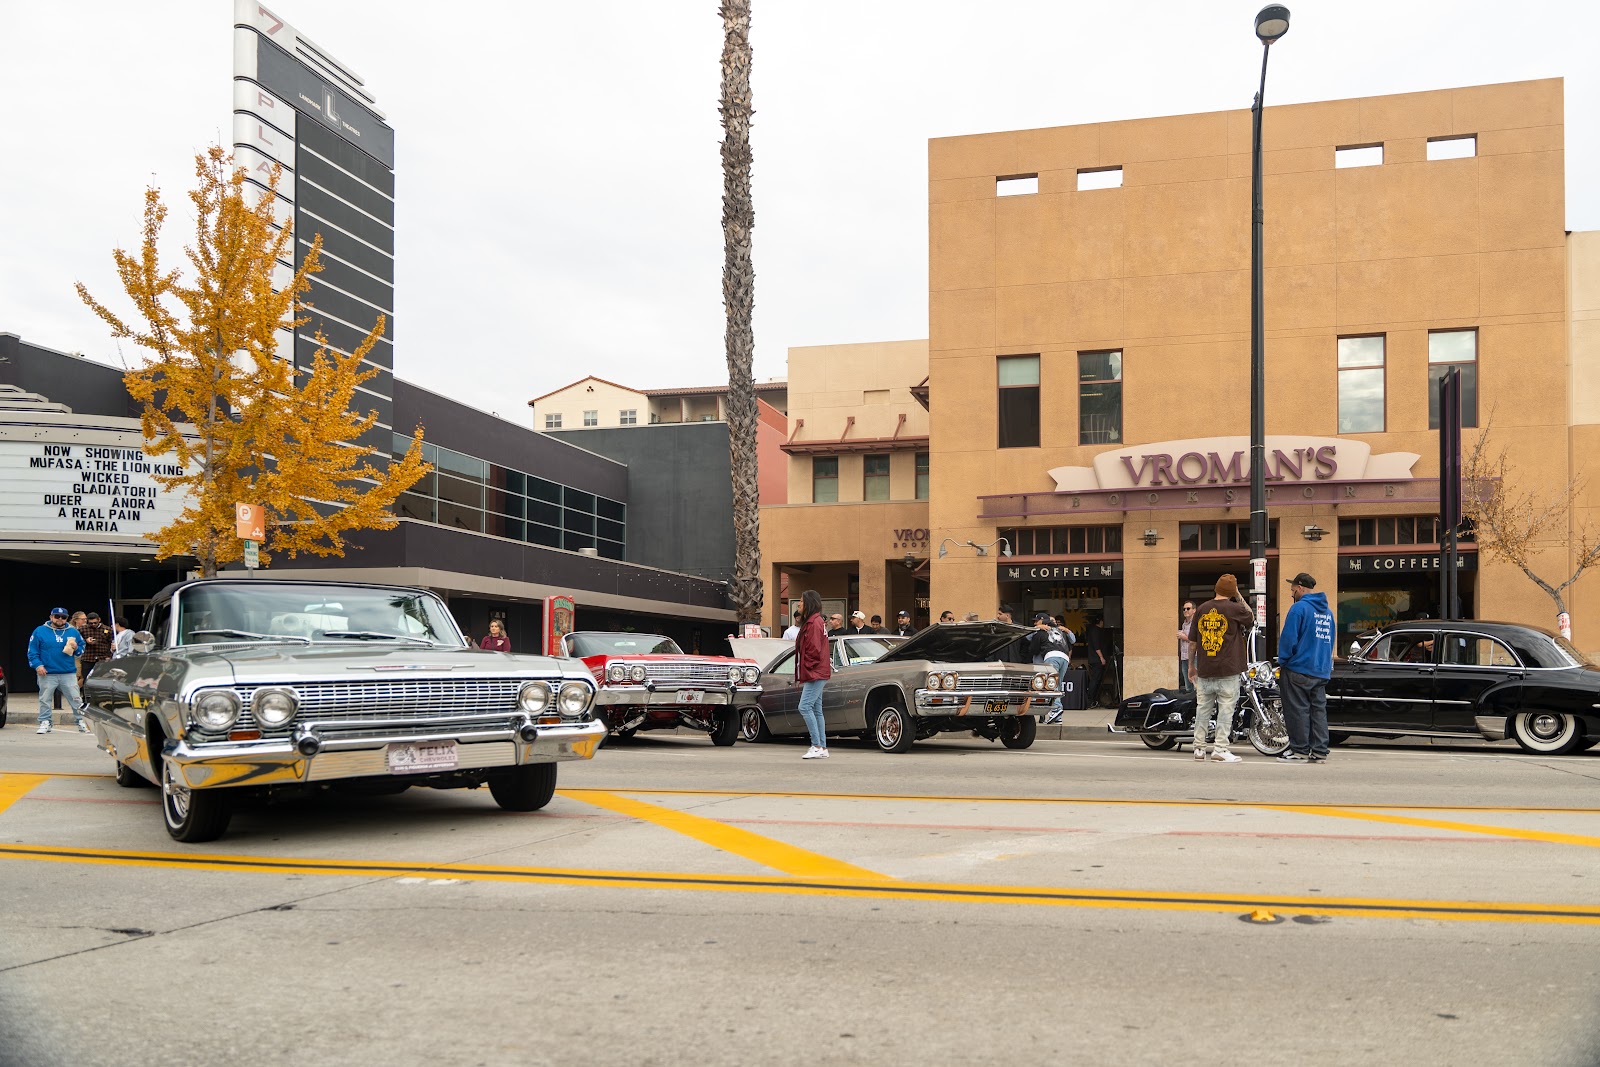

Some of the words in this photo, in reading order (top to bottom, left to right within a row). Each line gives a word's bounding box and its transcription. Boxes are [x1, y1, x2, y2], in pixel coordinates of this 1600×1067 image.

[44, 445, 71, 457] NOW
[85, 447, 143, 461] SHOWING
[95, 460, 118, 471] THE
[122, 461, 151, 473] LION
[154, 464, 183, 476] KING
[81, 471, 129, 484] WICKED
[73, 483, 146, 497] GLADIATOR
[148, 487, 157, 498] II
[1072, 485, 1395, 508] BOOKSTORE
[44, 494, 82, 506] QUEER
[112, 497, 155, 510] ANORA
[58, 507, 67, 518] A
[72, 507, 105, 519] REAL
[109, 509, 141, 521] PAIN
[75, 520, 118, 532] MARIA
[1373, 557, 1440, 570] COFFEE
[1030, 566, 1090, 578] COFFEE
[1049, 586, 1100, 600] TEPITO
[420, 746, 454, 756] FELIX
